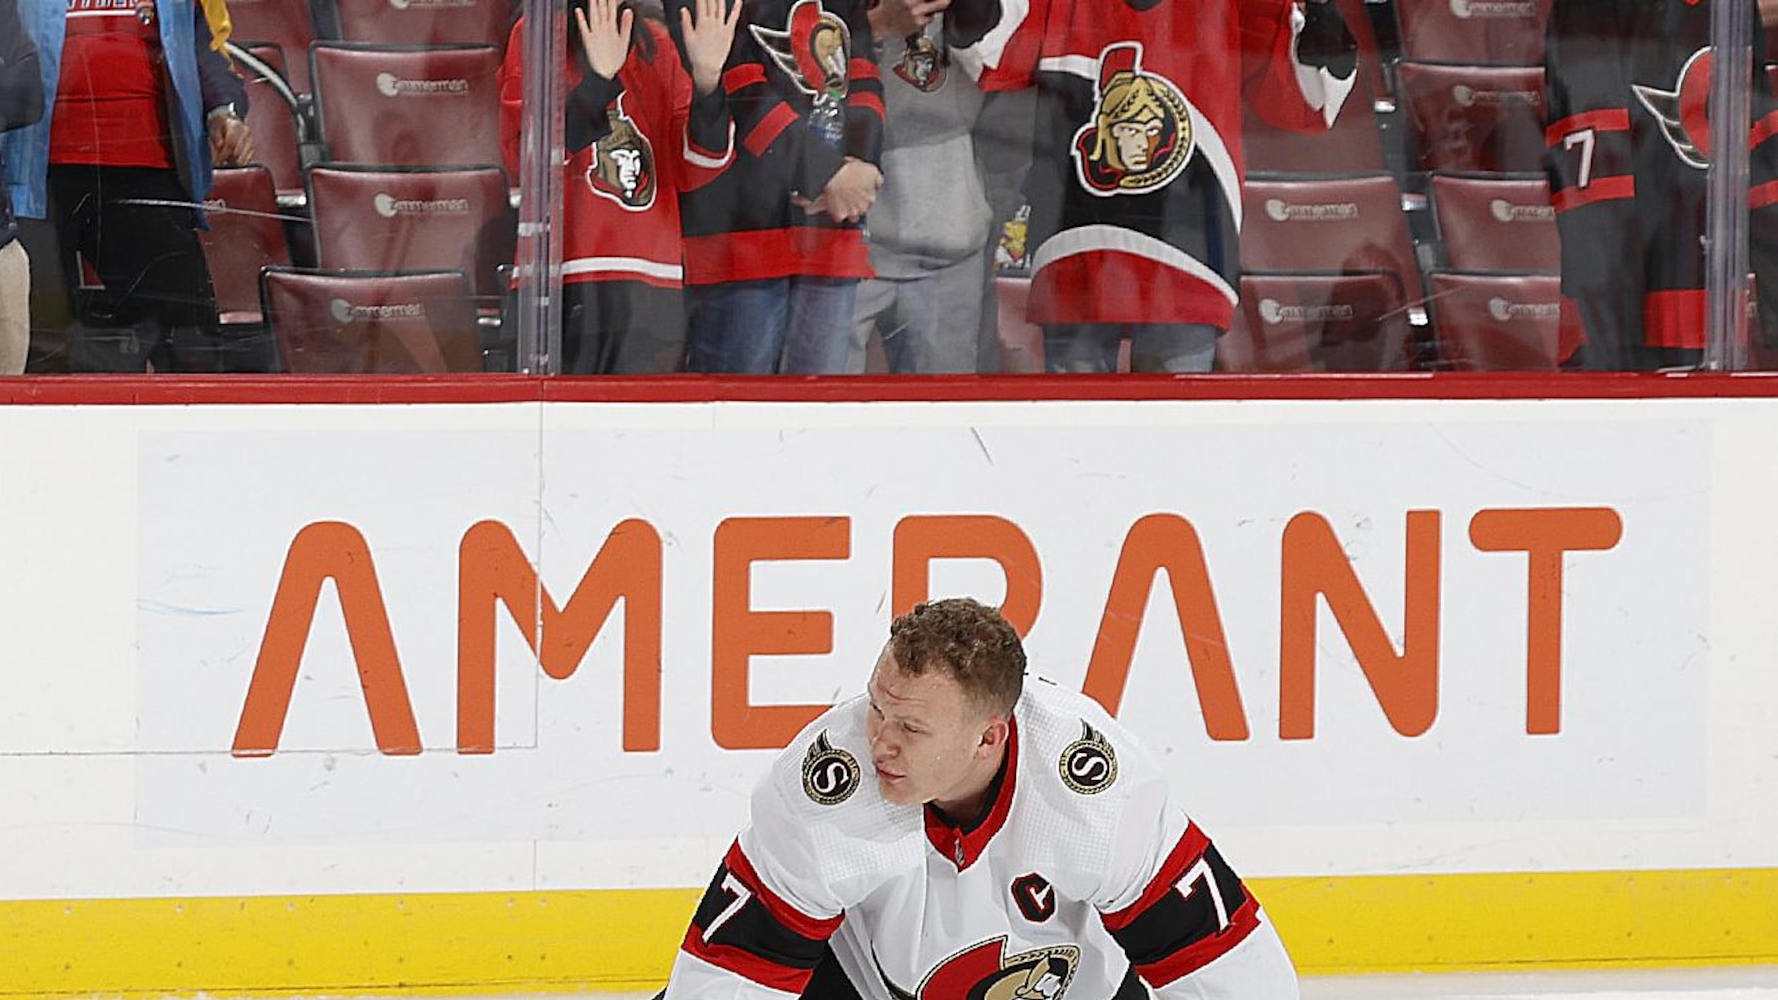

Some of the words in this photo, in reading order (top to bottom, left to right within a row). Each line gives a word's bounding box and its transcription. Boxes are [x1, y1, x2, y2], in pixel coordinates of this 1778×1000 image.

[1564, 129, 1594, 188] 7
[701, 872, 752, 944] 7
[1011, 873, 1057, 922] C
[1176, 857, 1229, 931] 7
